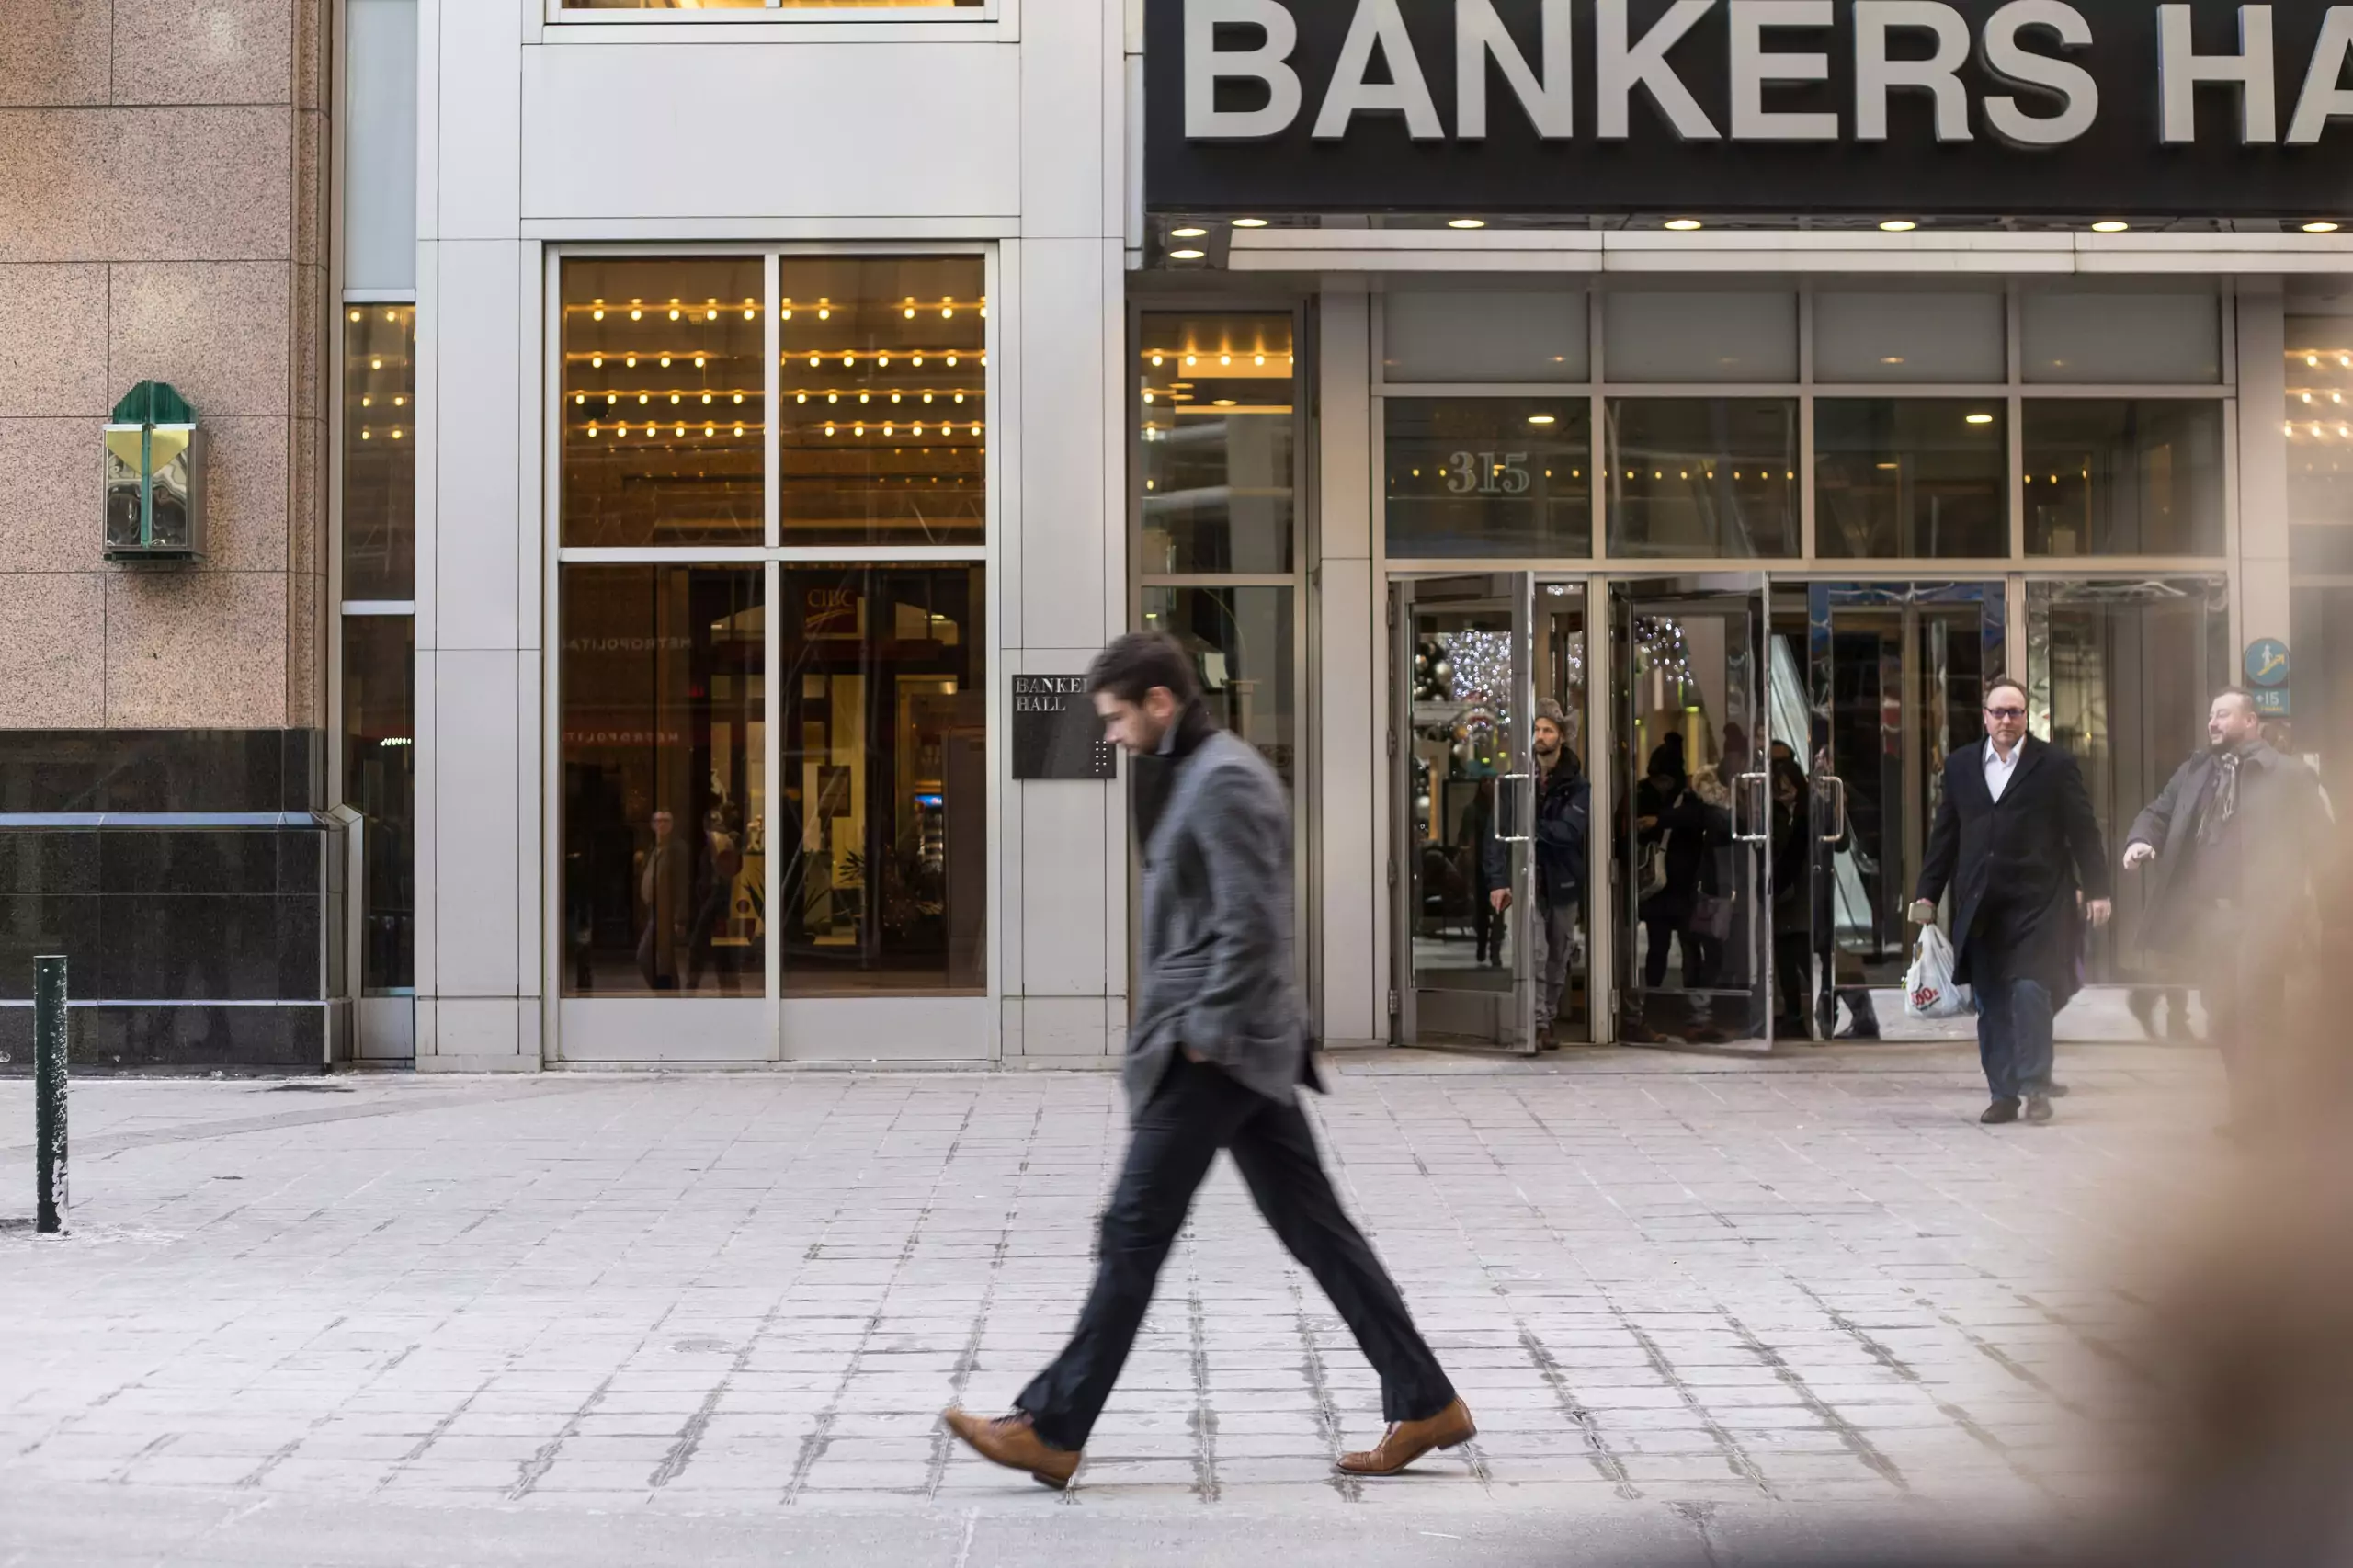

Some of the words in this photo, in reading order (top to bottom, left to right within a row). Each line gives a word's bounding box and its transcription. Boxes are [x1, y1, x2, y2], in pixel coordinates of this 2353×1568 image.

[1183, 0, 2098, 144] BANKERS
[1447, 451, 1530, 493] 315
[1016, 696, 1066, 711] HALL
